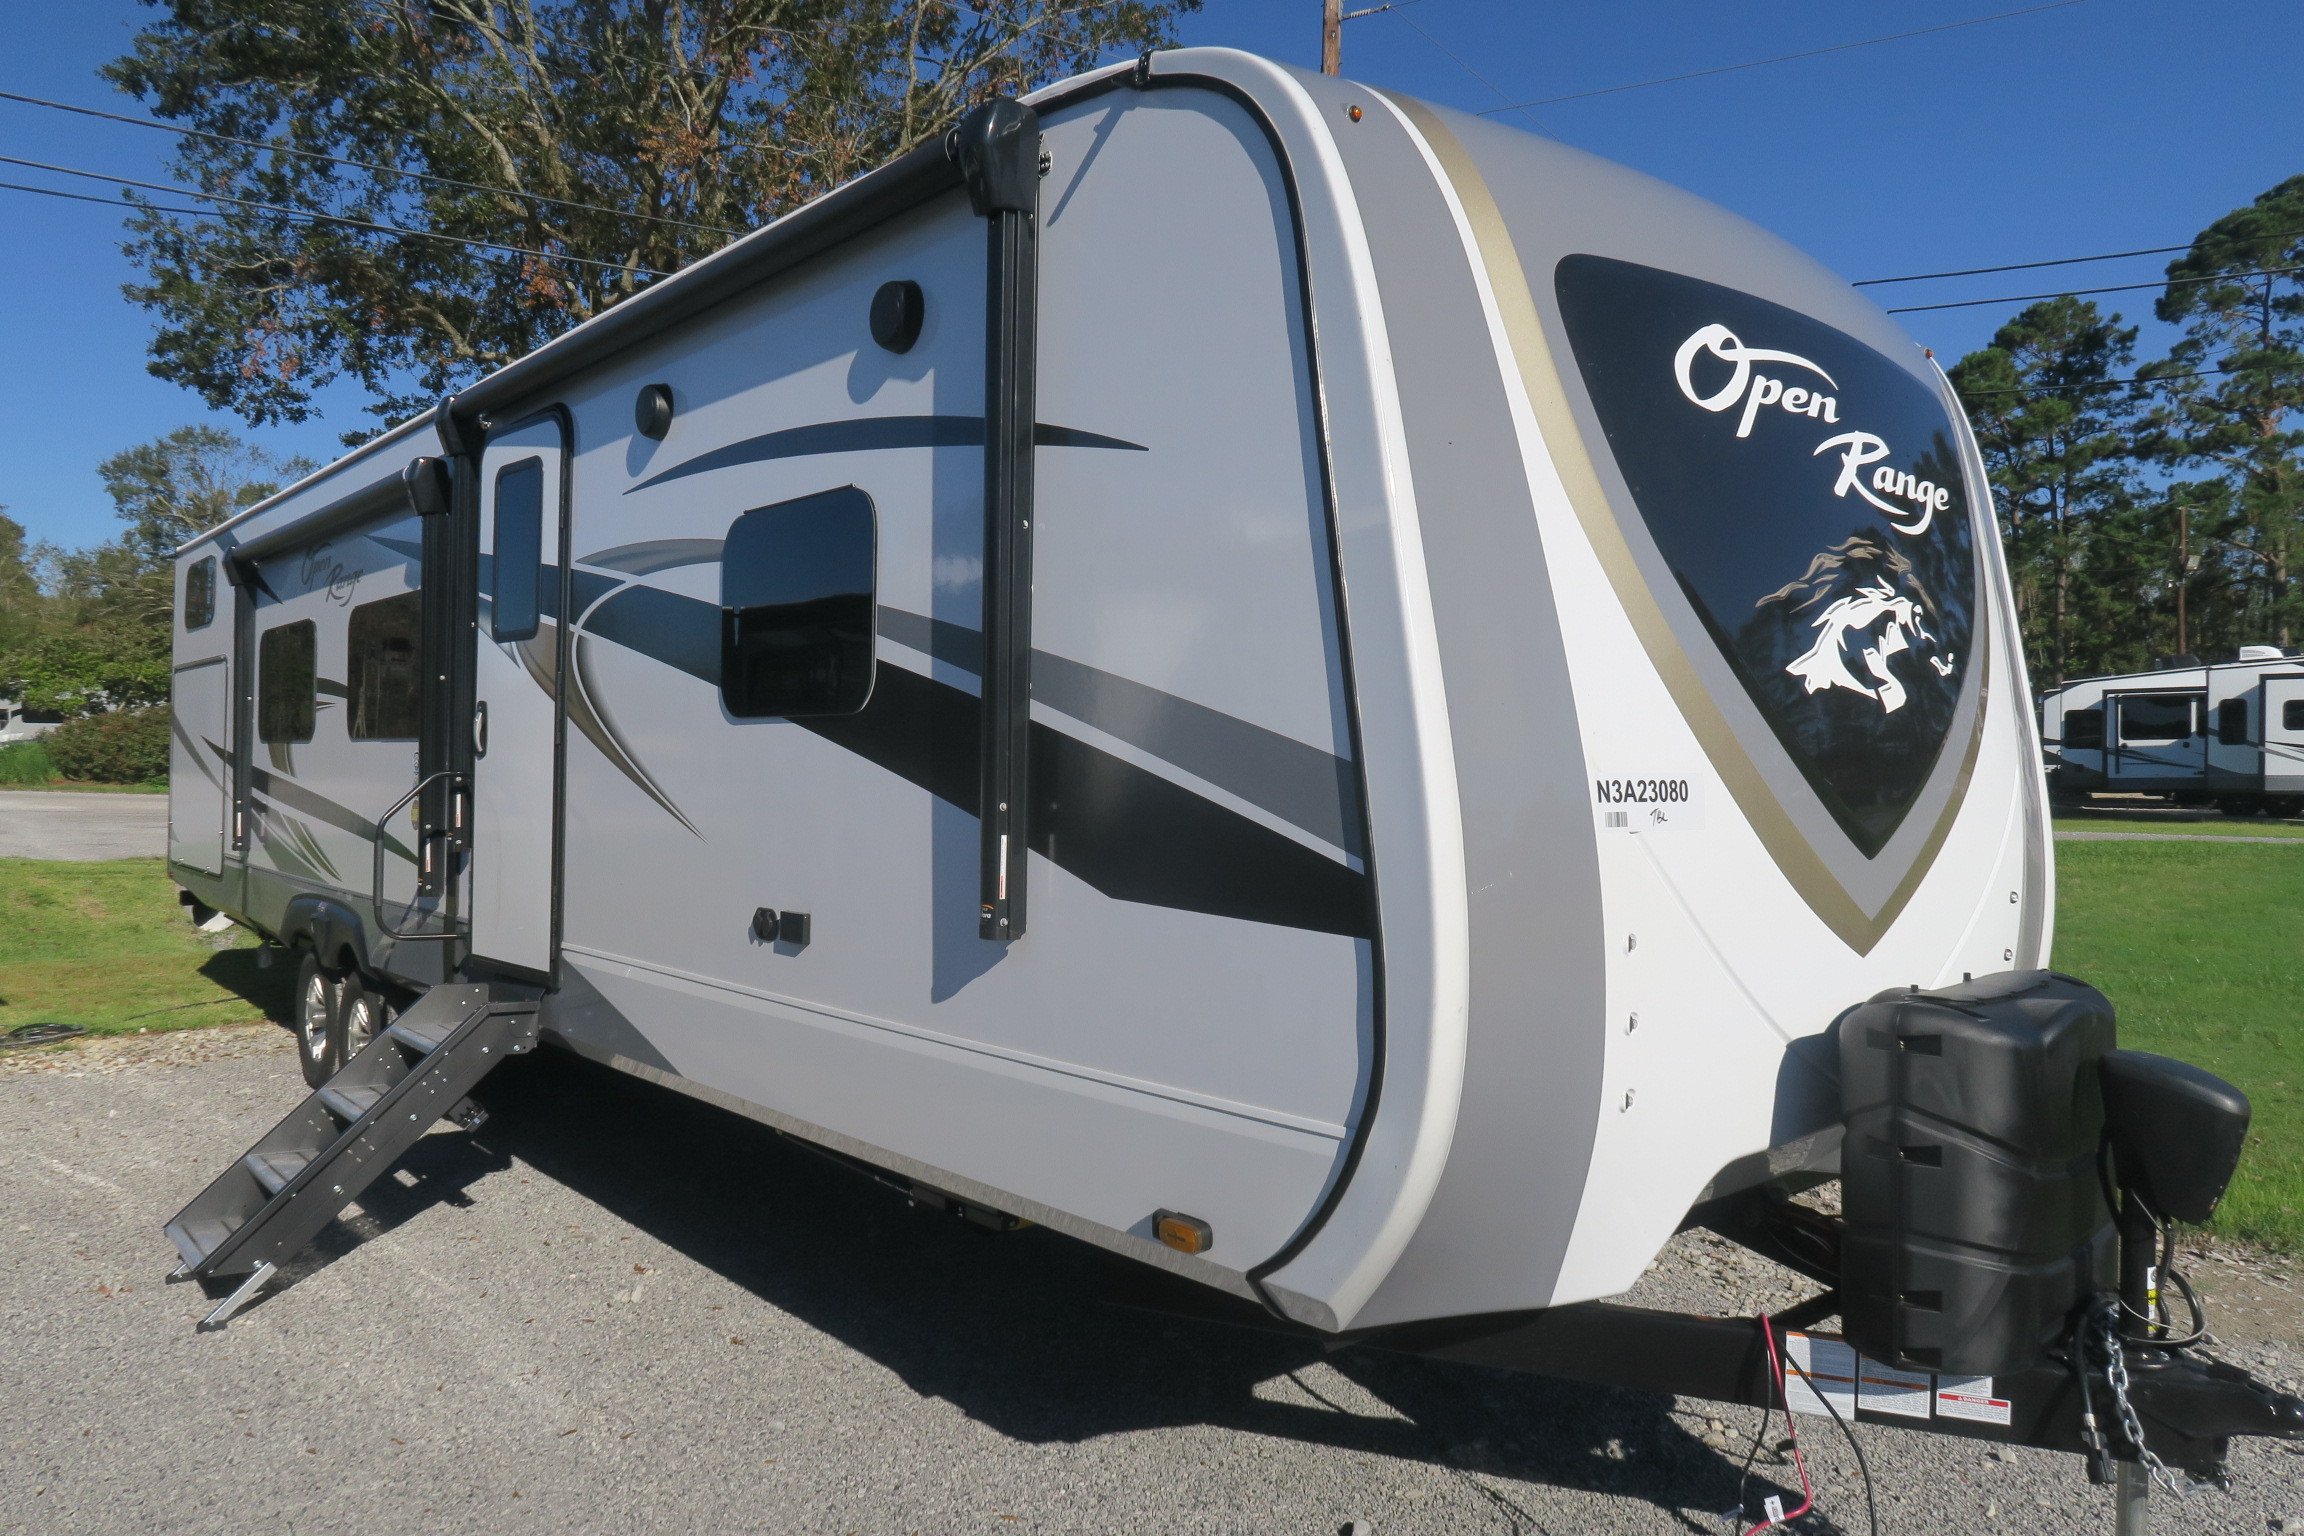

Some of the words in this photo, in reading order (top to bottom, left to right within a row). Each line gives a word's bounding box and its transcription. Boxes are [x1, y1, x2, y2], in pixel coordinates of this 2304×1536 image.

[1674, 324, 1840, 438] Open
[1812, 430, 1950, 536] Range
[1596, 779, 1689, 803] N3A23080
